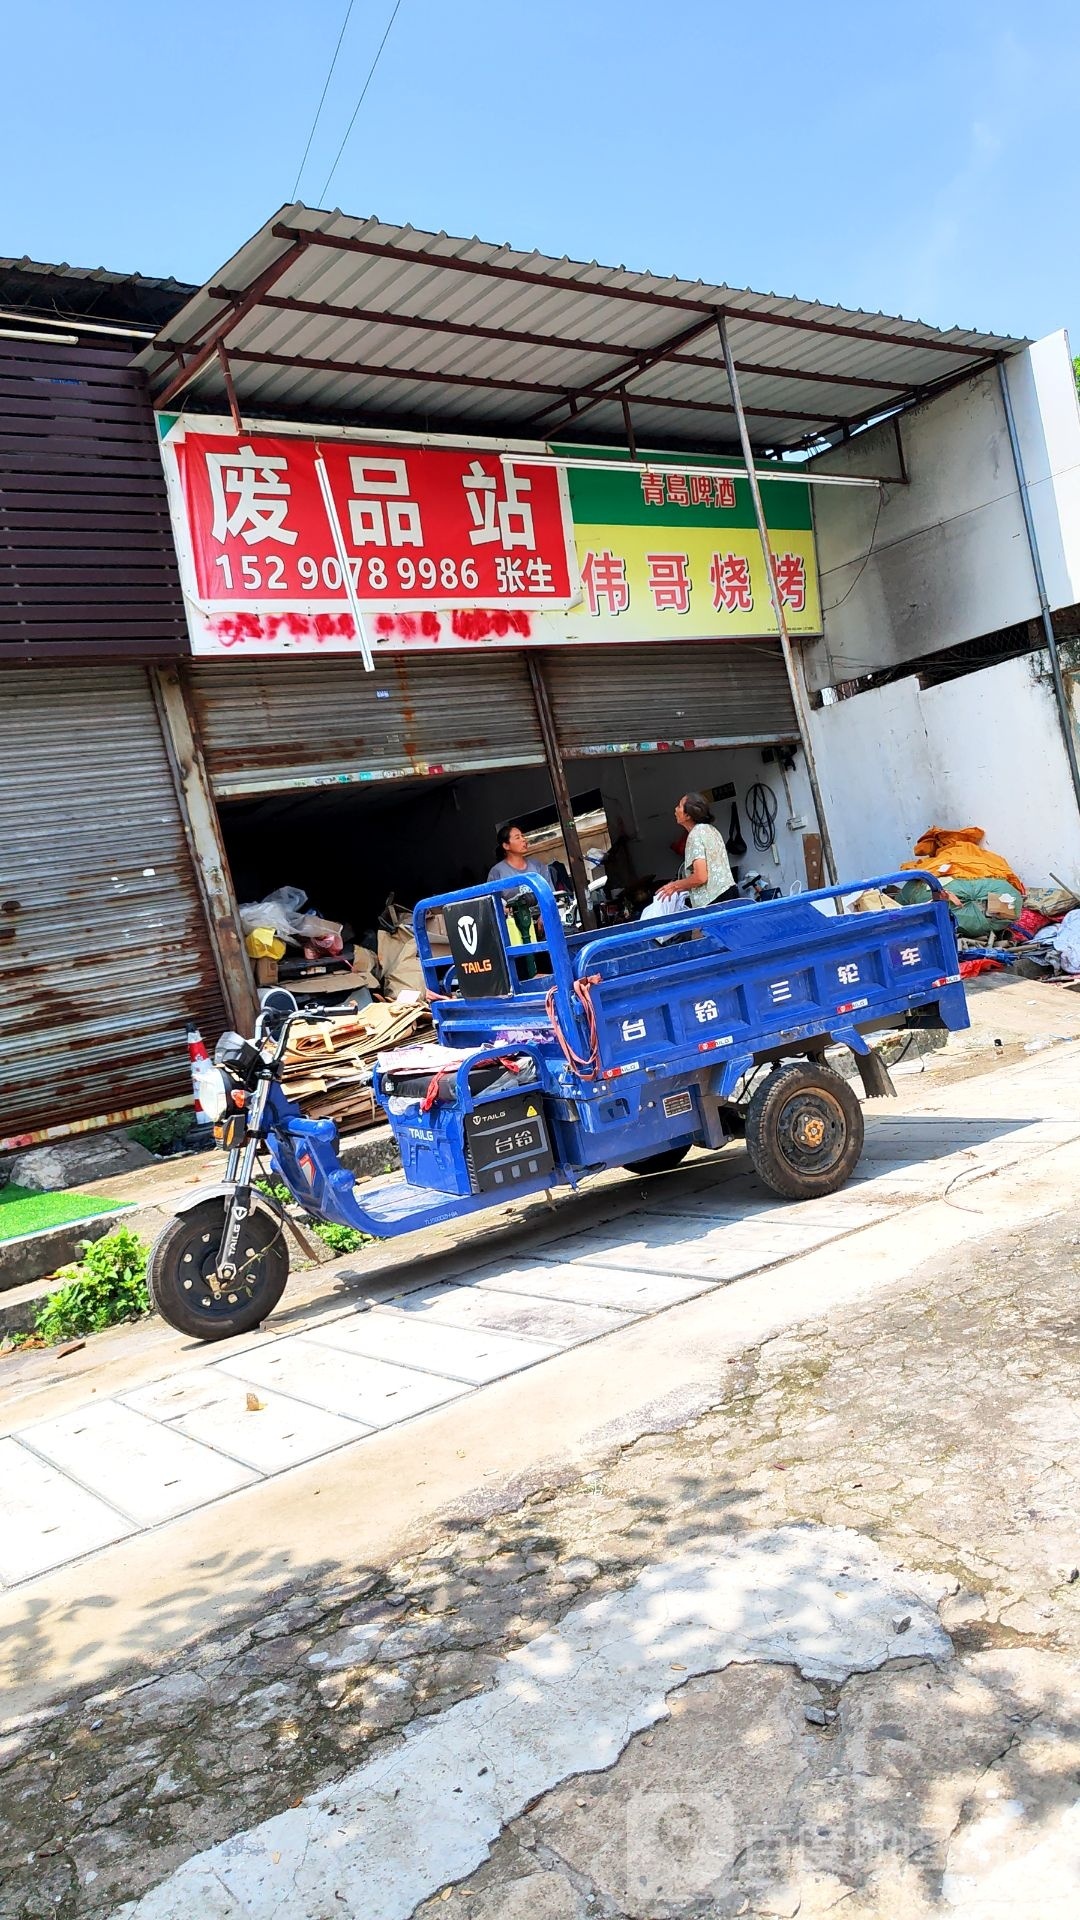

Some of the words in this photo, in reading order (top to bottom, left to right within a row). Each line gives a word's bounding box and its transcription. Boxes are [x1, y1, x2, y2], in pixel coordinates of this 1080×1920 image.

[204, 444, 537, 552] 废品站
[640, 471, 737, 509] 青岛啤酒
[215, 554, 288, 591] 152
[297, 555, 388, 591] 9078
[397, 556, 479, 591] 9986
[495, 556, 556, 594] 张生
[581, 551, 807, 616] 伟哥烧烤
[461, 959, 493, 975] TAILG
[482, 1111, 506, 1122] TAILG
[408, 1127, 434, 1142] TAILG
[494, 1130, 534, 1154] 台铃
[228, 1224, 241, 1257] TAILG
